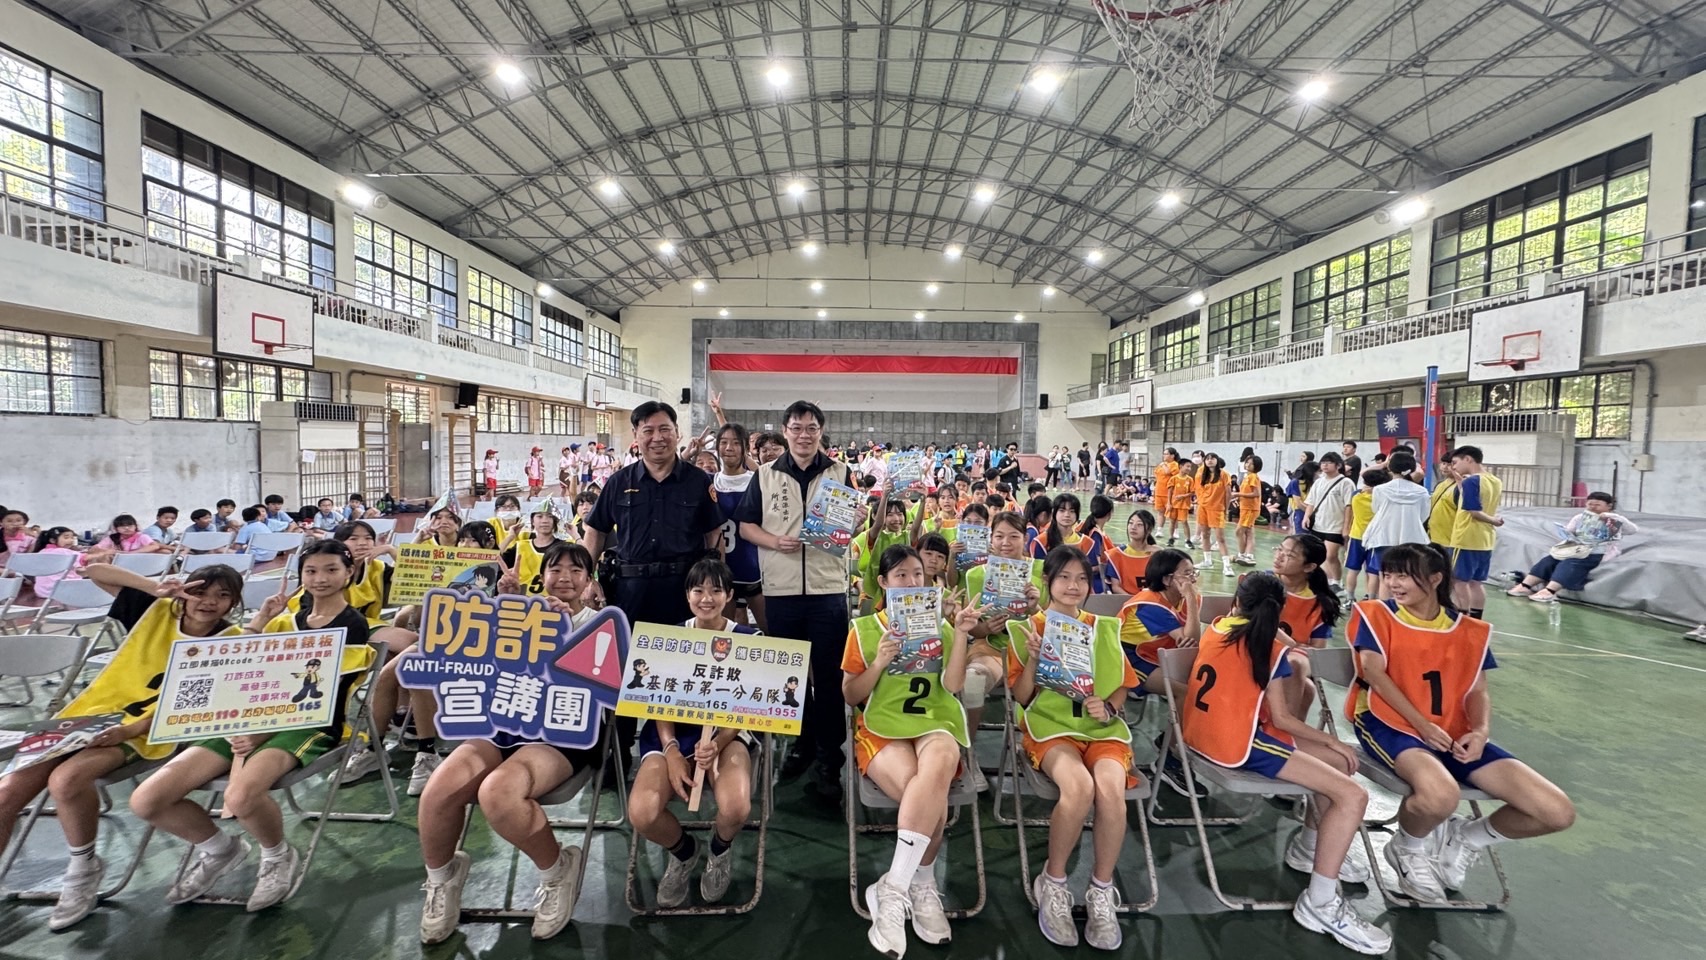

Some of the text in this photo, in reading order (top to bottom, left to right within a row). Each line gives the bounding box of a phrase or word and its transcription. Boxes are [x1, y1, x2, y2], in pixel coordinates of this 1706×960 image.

[425, 593, 562, 664] 防詐
[636, 635, 804, 666] 全民防詐騙 攜手護治安
[223, 670, 266, 682] 打詐成效
[402, 658, 495, 676] ANTI-FRAUD
[692, 663, 742, 682] 反詐欺
[239, 680, 281, 692] 高發手法
[646, 675, 780, 703] 基隆市第一分局隊
[902, 676, 931, 715] 2
[1195, 663, 1217, 713] 2
[1422, 670, 1443, 717] 1
[439, 670, 592, 732] 宣講團
[646, 705, 745, 724] 基隆市警察局第一分局
